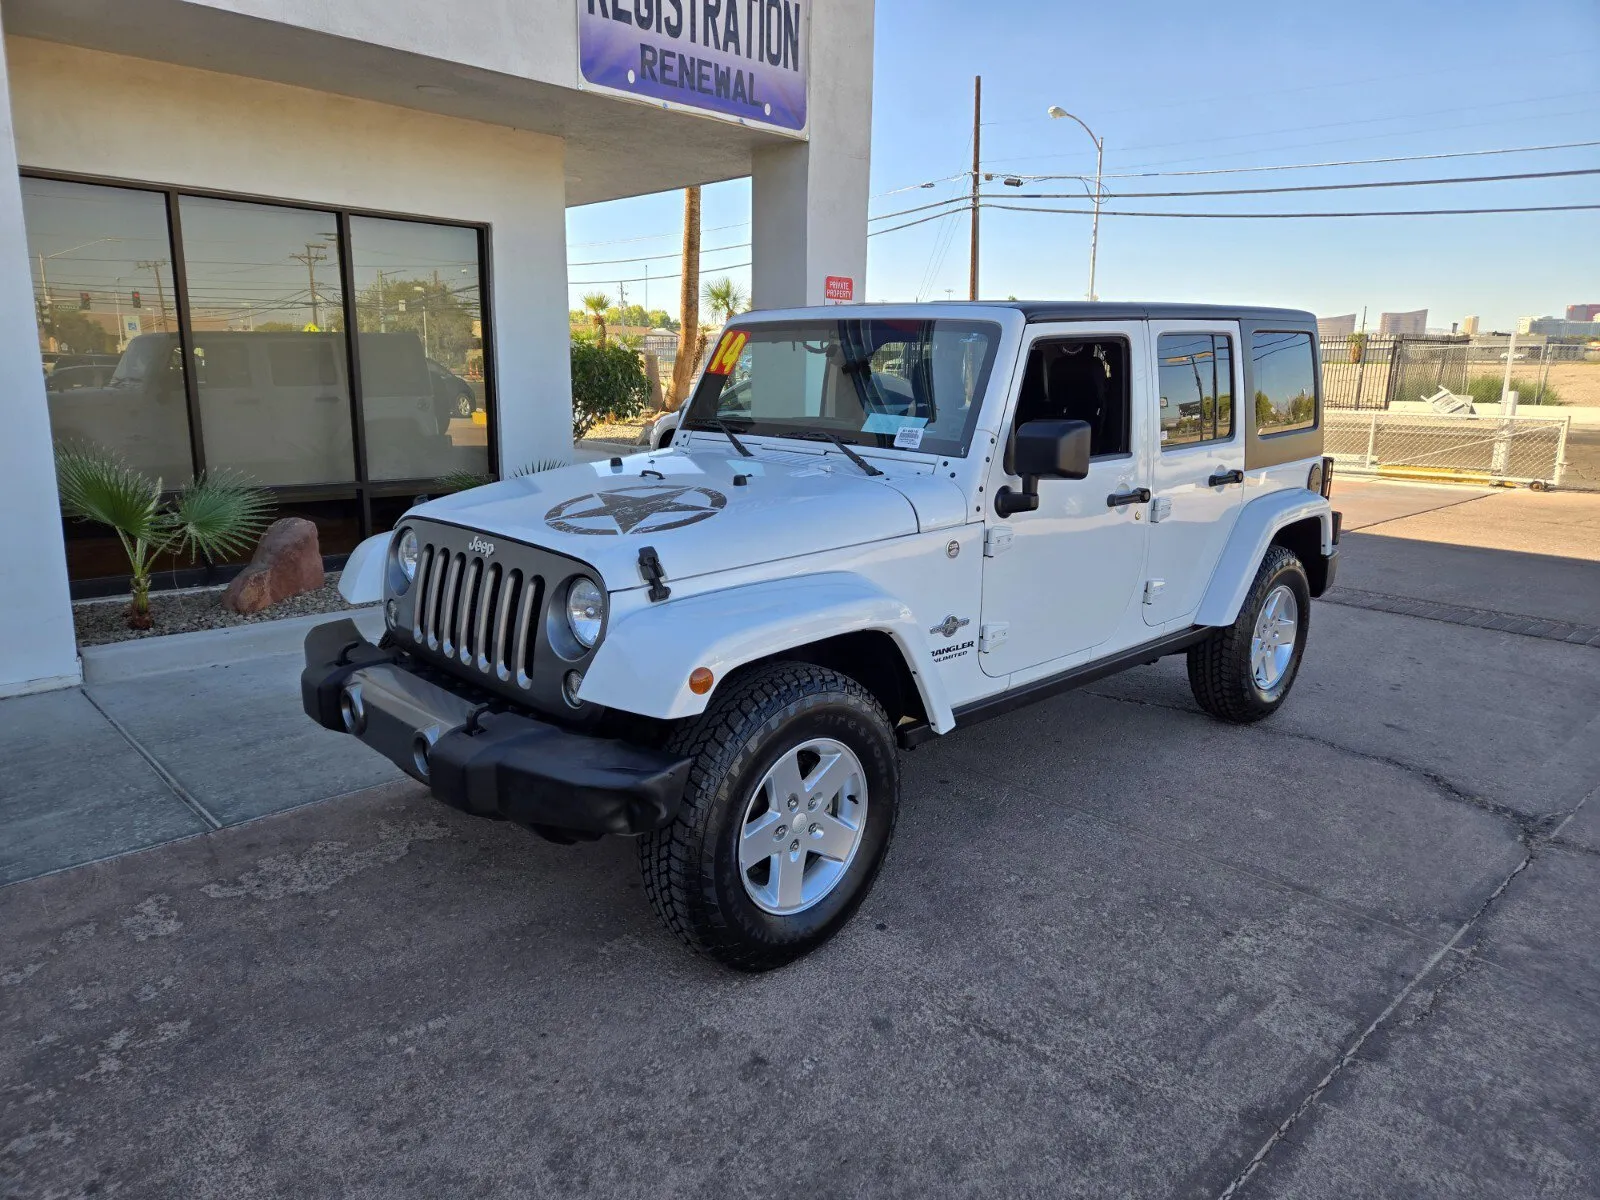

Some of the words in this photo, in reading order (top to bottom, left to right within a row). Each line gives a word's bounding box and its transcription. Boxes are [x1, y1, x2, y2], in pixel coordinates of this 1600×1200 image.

[587, 0, 800, 72] STRATION
[639, 43, 763, 108] RENEWAL
[826, 289, 852, 299] PROPERTY
[829, 281, 849, 290] PRIVATE
[710, 331, 746, 374] 14
[468, 535, 495, 558] Jeep
